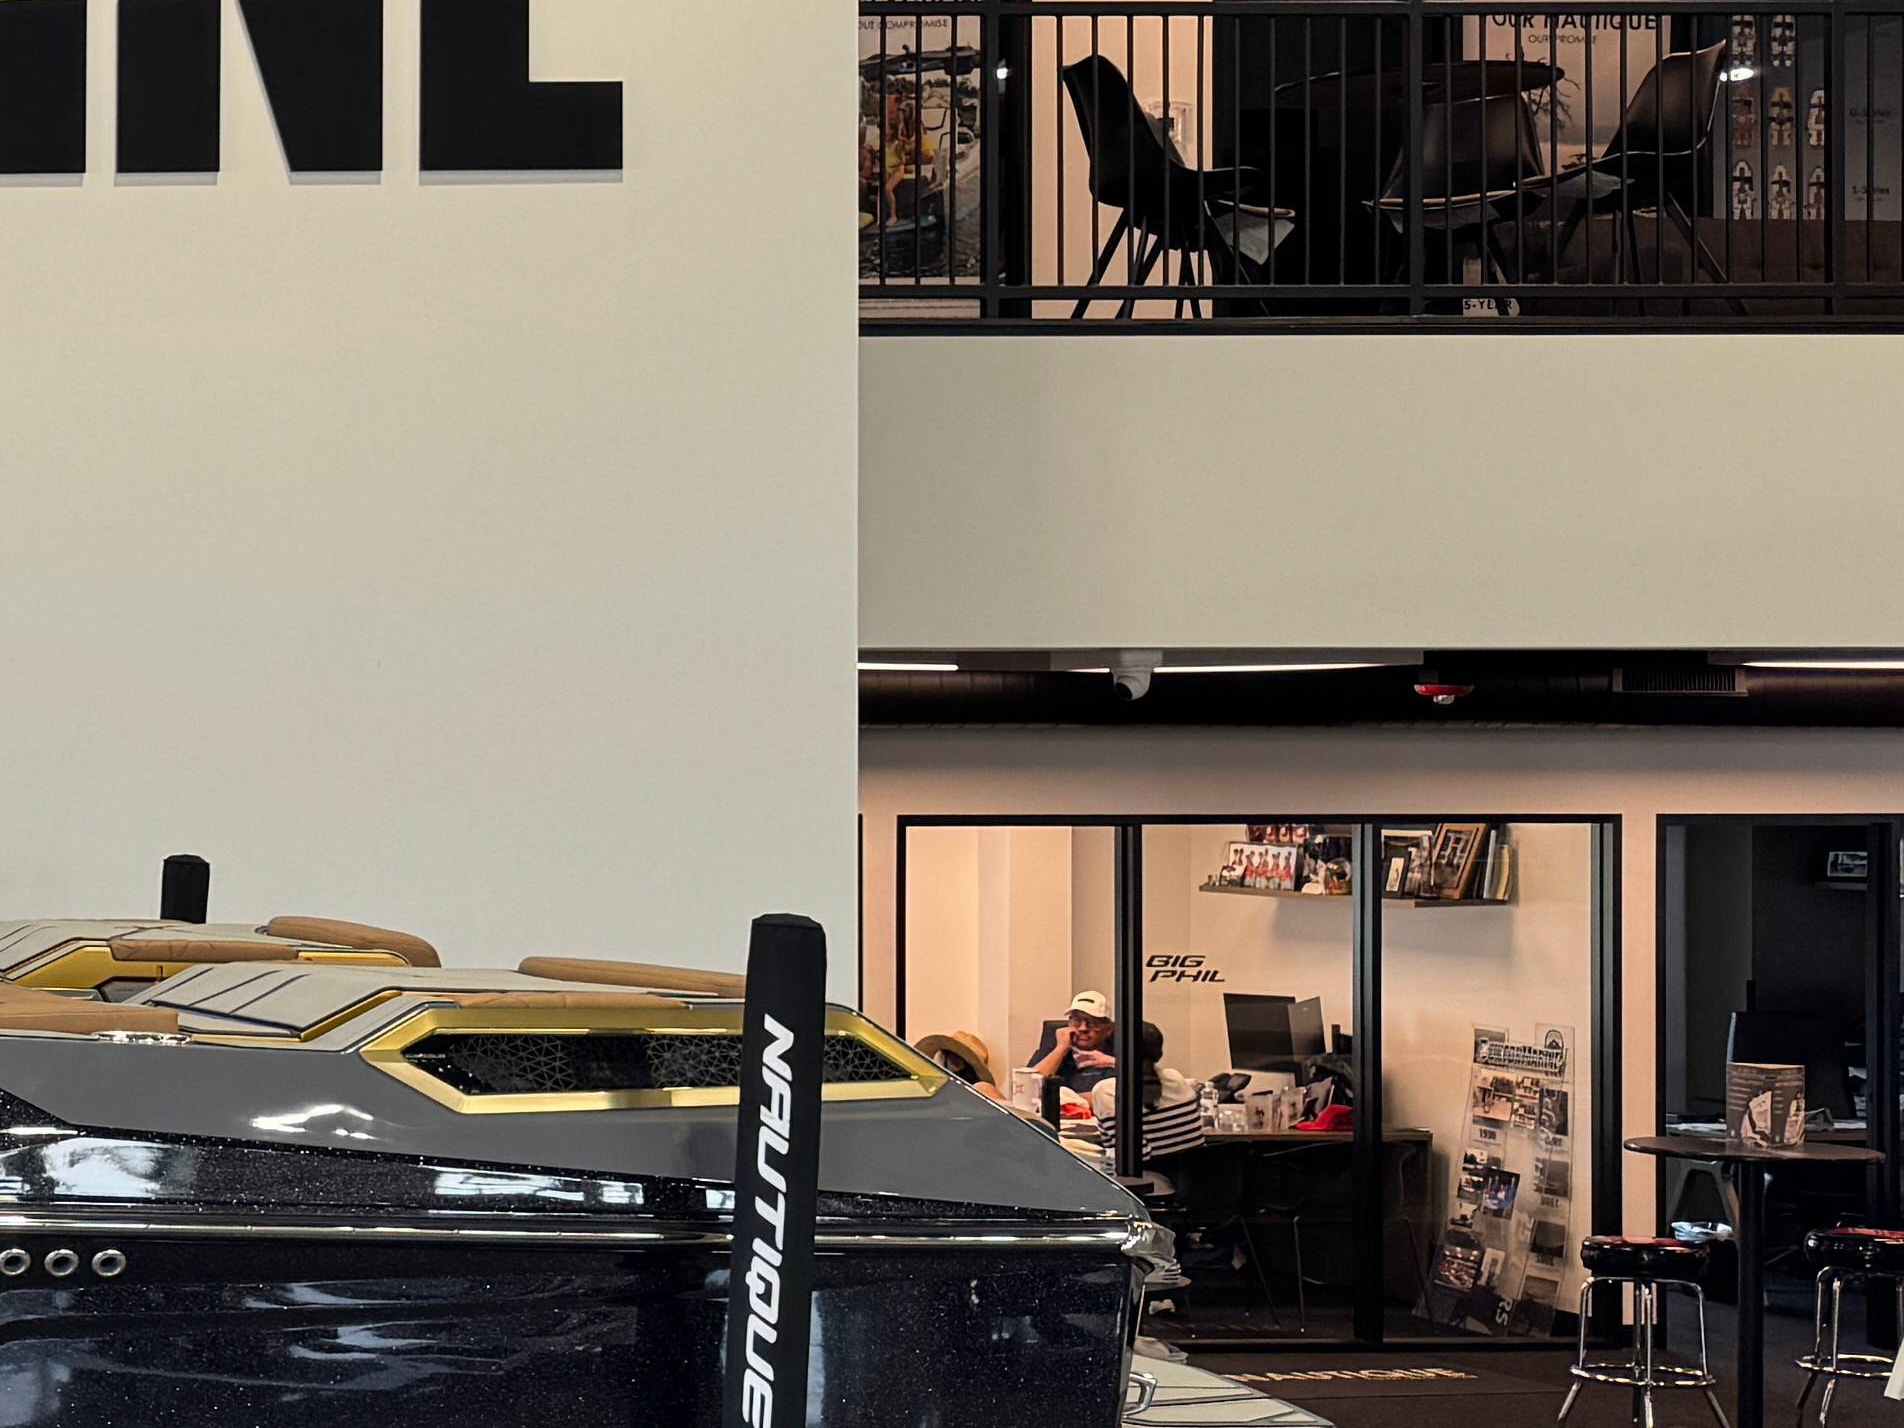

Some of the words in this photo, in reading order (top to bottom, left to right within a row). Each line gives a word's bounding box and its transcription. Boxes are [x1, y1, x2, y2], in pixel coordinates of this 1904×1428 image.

[1463, 298, 1512, 311] 5-YER
[1145, 955, 1206, 968] BIG
[1150, 969, 1225, 983] PHIL
